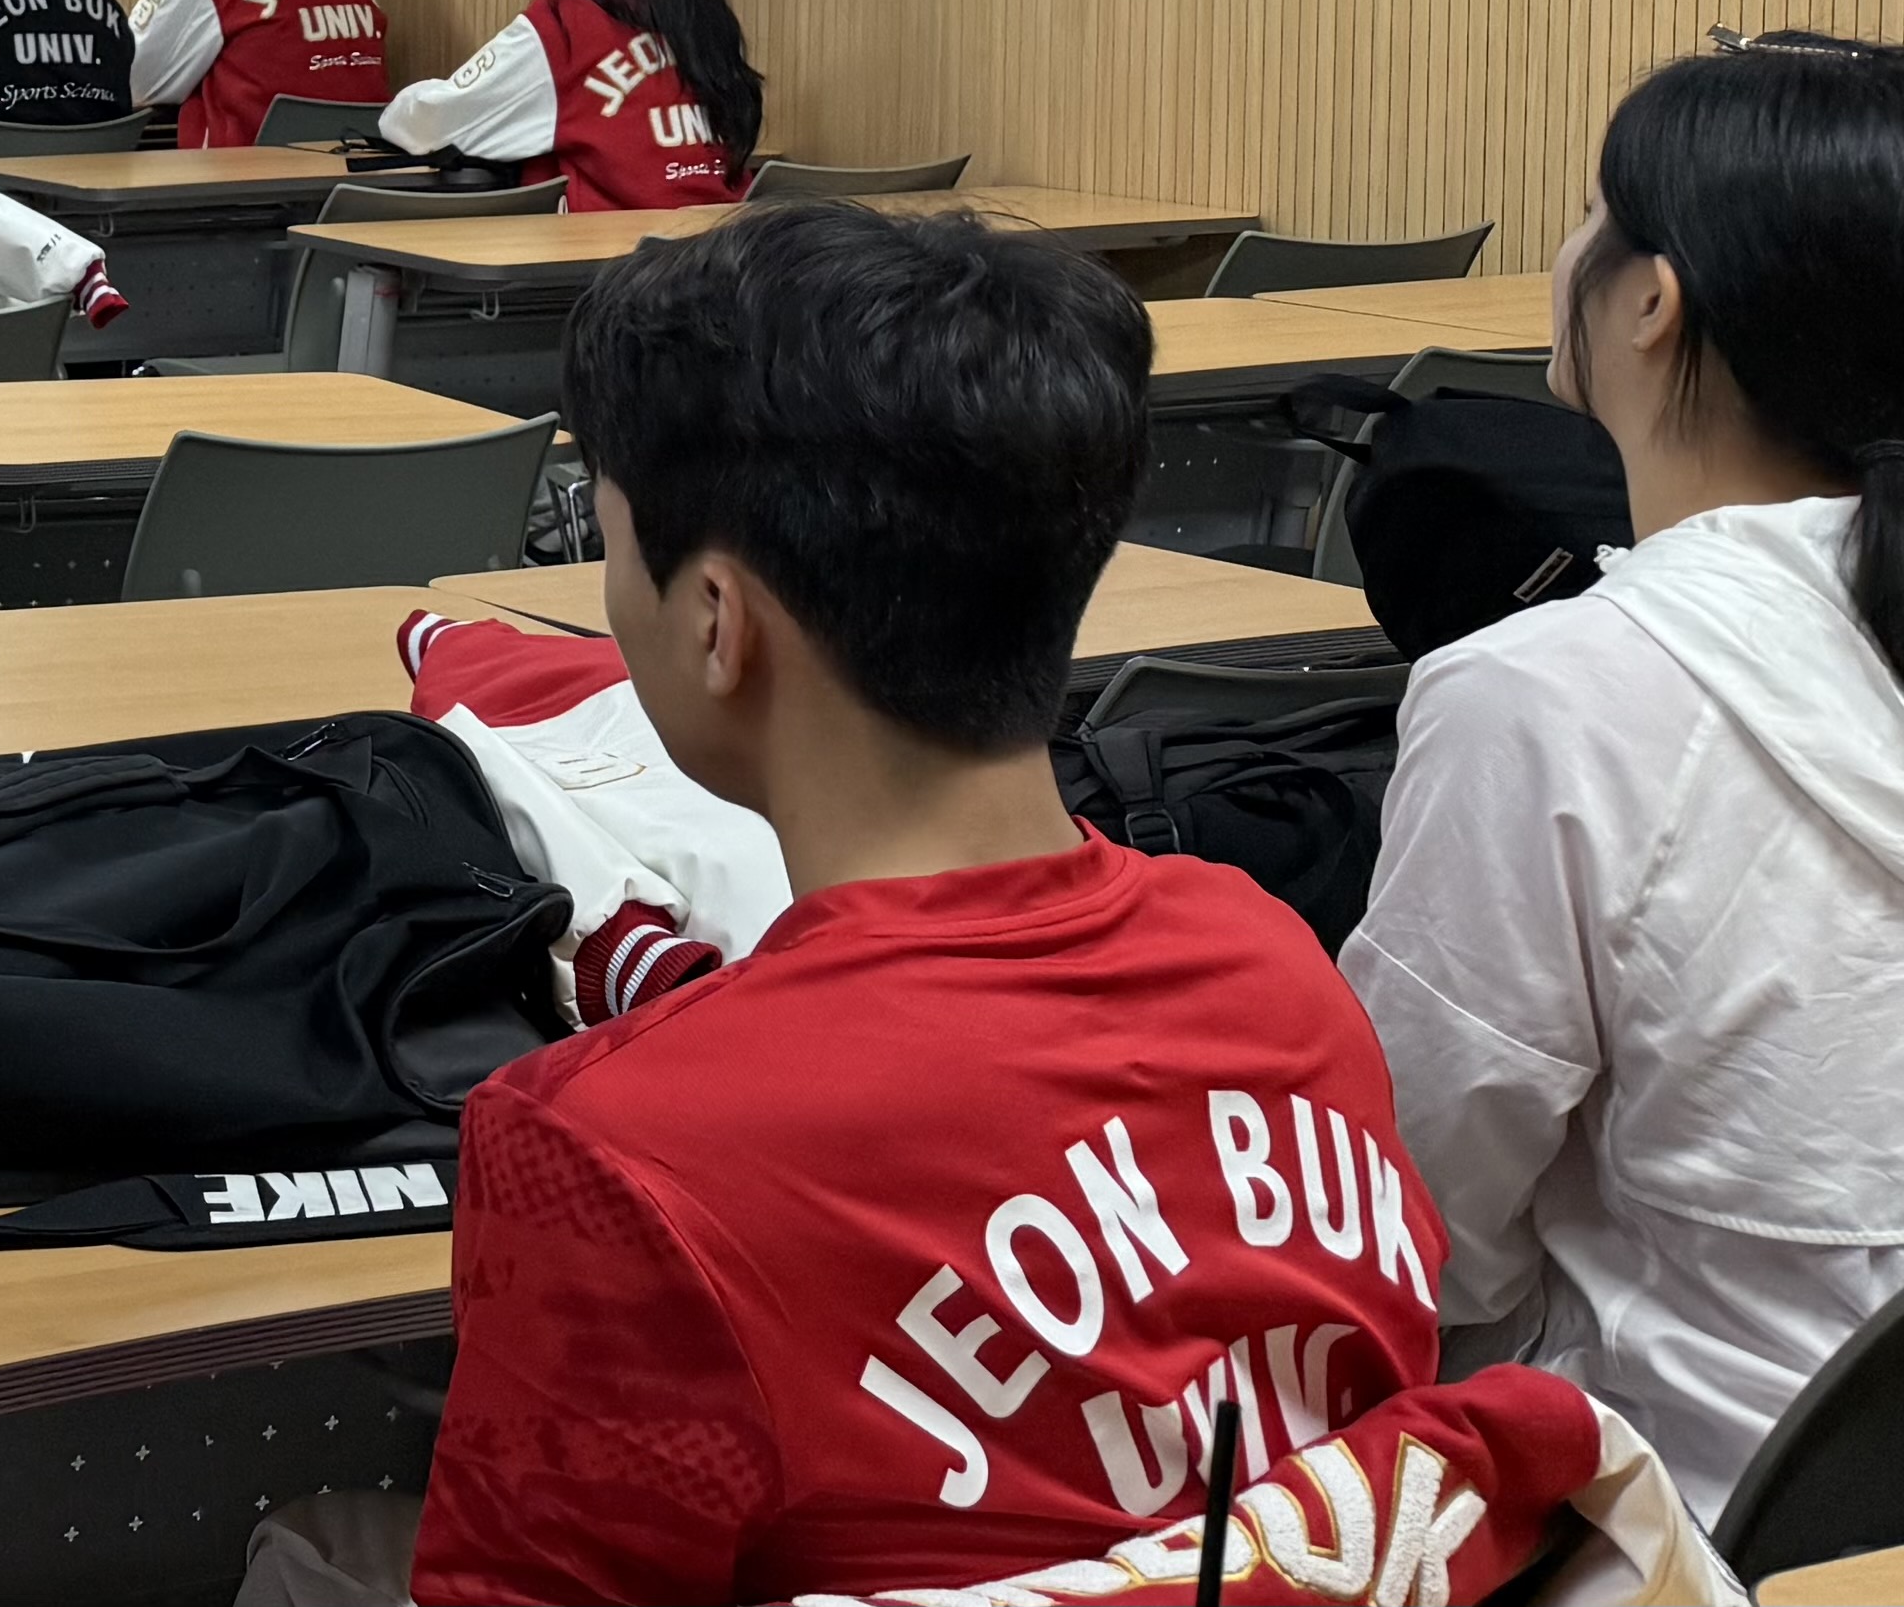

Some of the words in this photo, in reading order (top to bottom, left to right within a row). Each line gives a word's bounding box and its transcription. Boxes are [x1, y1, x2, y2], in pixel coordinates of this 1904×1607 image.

[299, 4, 381, 42] UNIV.
[13, 33, 102, 65] UNIV.
[0, 83, 58, 110] Sports
[194, 1162, 449, 1224] NIKE
[859, 1115, 1190, 1510] JEON
